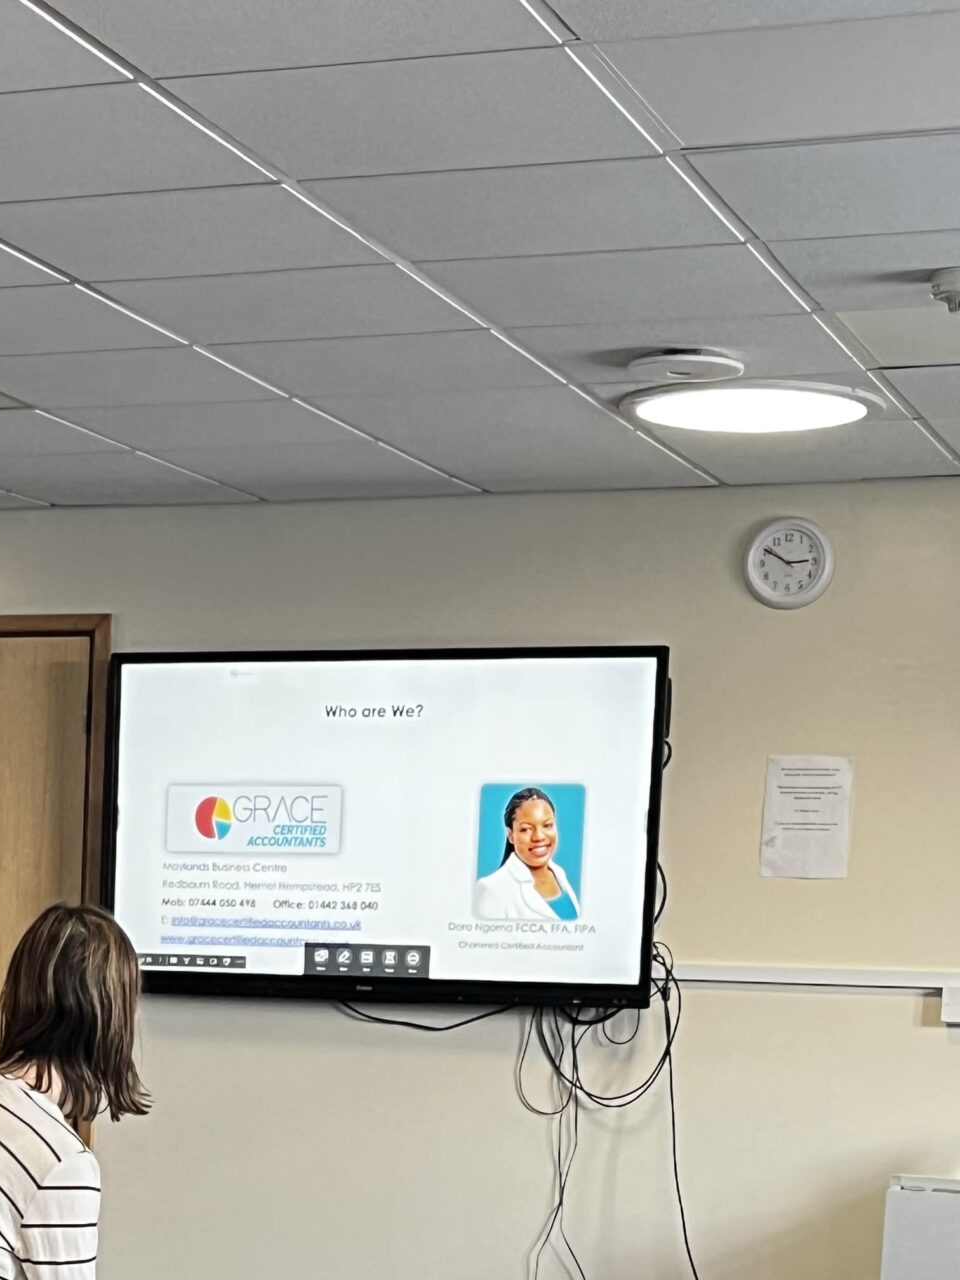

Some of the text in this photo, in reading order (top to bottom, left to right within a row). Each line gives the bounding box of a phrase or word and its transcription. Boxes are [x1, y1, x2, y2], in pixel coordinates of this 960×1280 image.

[785, 532, 794, 543] 12
[325, 704, 424, 718] Who are We?
[232, 795, 328, 824] GRACE
[273, 824, 327, 836] CERTIFIED
[246, 836, 326, 848] ACCOUNTANTS
[252, 862, 287, 874] Centre
